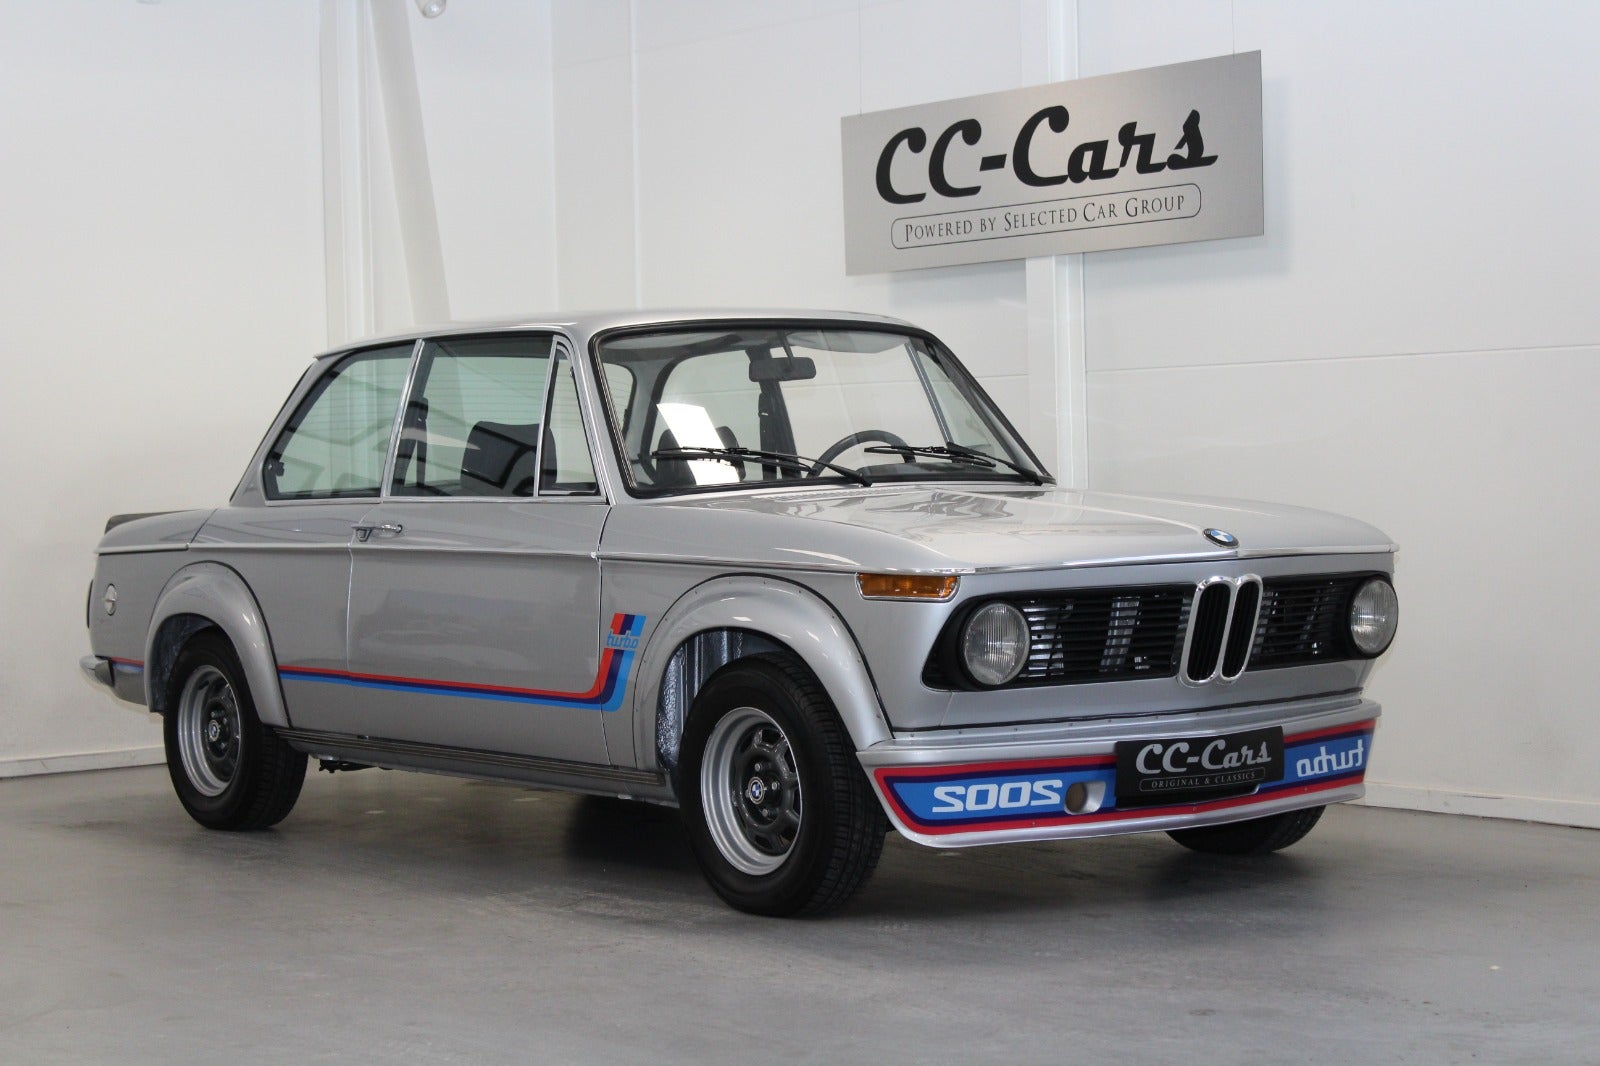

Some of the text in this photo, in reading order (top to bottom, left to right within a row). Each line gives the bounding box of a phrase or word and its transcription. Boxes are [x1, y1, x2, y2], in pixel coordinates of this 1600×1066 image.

[875, 105, 1219, 205] CC-Cars
[905, 195, 1185, 242] POWERED BY SELECTED CAR GROUP
[606, 630, 639, 649] turbo
[1135, 739, 1272, 775] CC-Cars
[1151, 771, 1256, 789] ORIGINAL & CLASSICS
